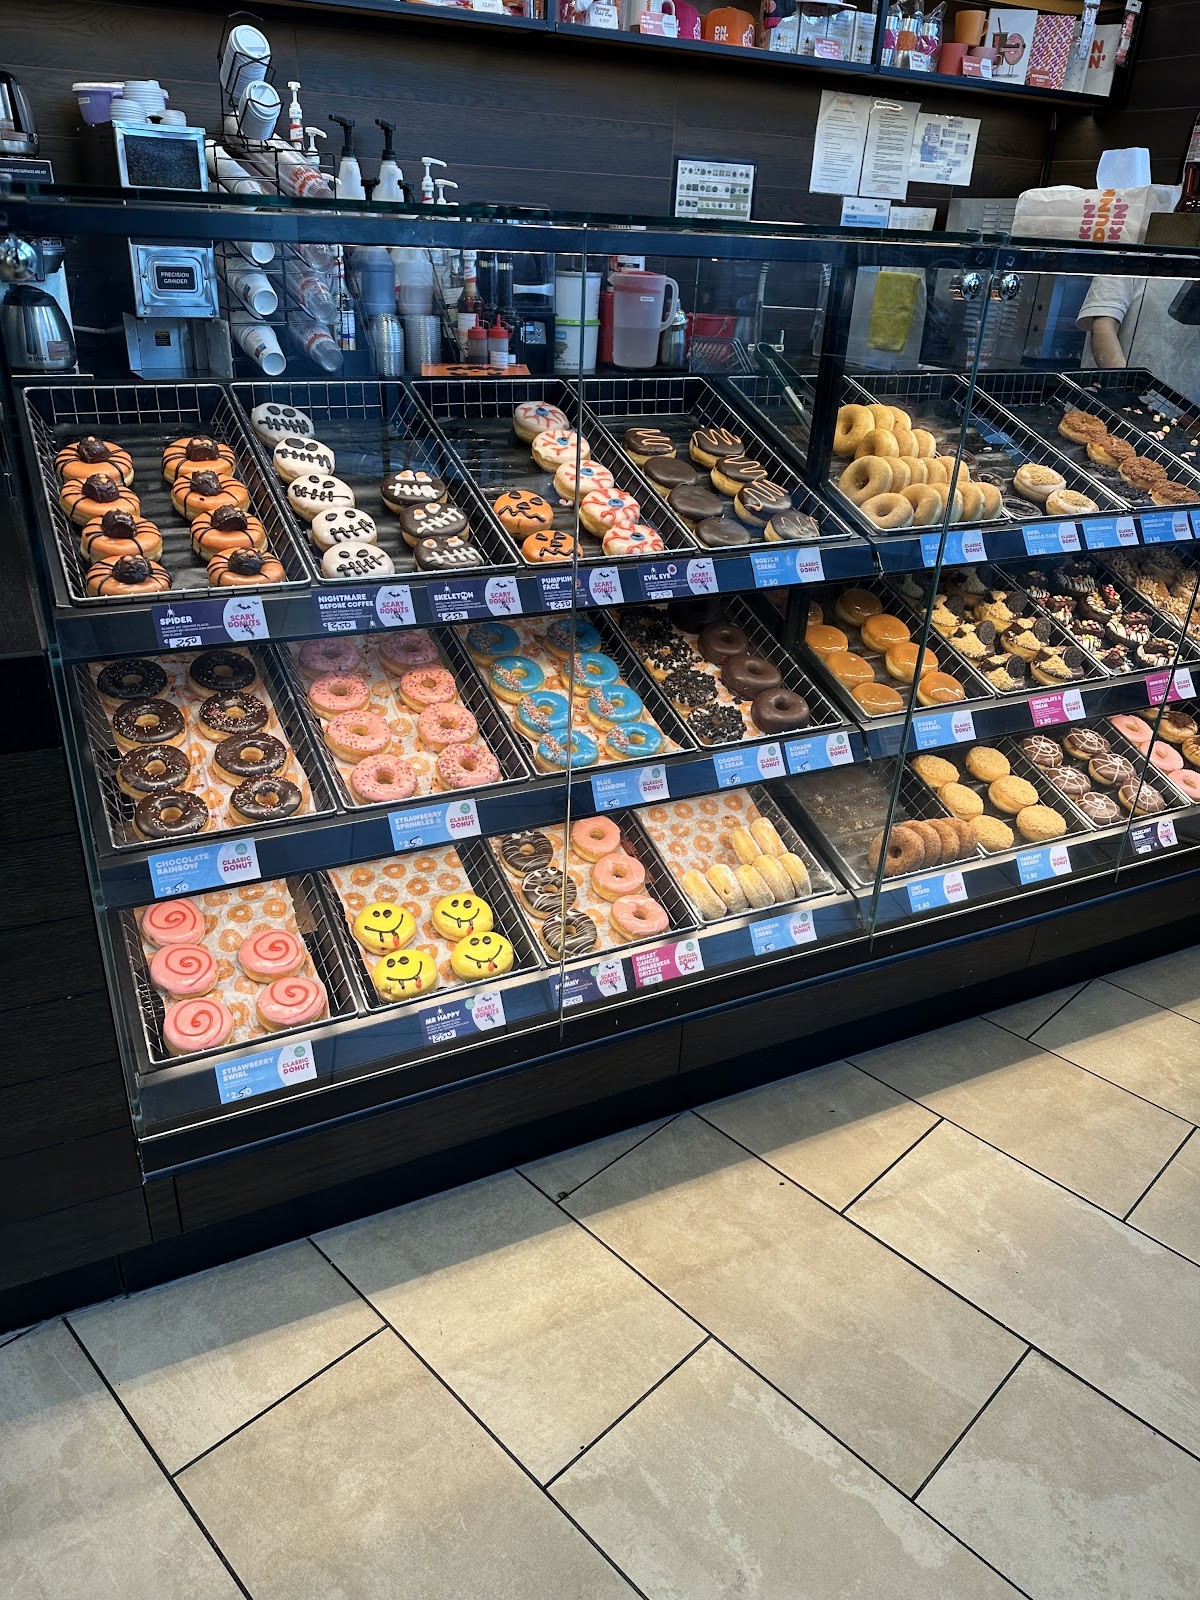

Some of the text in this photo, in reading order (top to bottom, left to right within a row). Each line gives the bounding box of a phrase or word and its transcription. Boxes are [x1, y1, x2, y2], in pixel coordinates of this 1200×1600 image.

[1079, 199, 1095, 239] KIN'
[541, 576, 572, 584] PUMPKIN
[658, 572, 671, 580] EYE
[542, 583, 560, 591] FACE
[318, 594, 367, 603] NIGHTMARE
[434, 591, 474, 601] SKELETON
[319, 602, 346, 610] BEFORE
[160, 615, 193, 626] SPIDER
[230, 613, 255, 622] SCARY
[228, 619, 261, 628] DONUTS
[830, 749, 848, 757] DONUT
[718, 755, 743, 765] COOKIES
[724, 761, 744, 769] CREAM
[761, 761, 780, 769] DONUT
[596, 778, 612, 786] BLUE
[597, 782, 626, 792] RAINBOW
[643, 784, 663, 792] DONUT
[395, 811, 442, 824] STRAWBERRY
[450, 815, 474, 823] CLASSIC
[396, 818, 434, 831] SPRINKLES
[451, 820, 475, 829] DONUT
[155, 853, 210, 868] CHOCOLATE
[222, 855, 252, 866] CLASSIC
[157, 862, 198, 876] RAINBOW
[223, 861, 253, 872] DONUT
[754, 922, 780, 933] BAVARIAN
[793, 922, 810, 930] CLASSIC
[794, 926, 811, 935] DONUT
[636, 951, 656, 962] BREAST
[678, 952, 697, 960] SPECIAL
[679, 956, 698, 966] DONUT
[637, 957, 659, 967] CANCER
[638, 959, 670, 972] AWARENESS
[601, 971, 617, 980] SCARY
[639, 967, 662, 977] DRIZZLE
[600, 976, 621, 985] DONUTS
[475, 1008, 499, 1019] DONUTS
[477, 1004, 495, 1013] SCARY
[425, 1010, 460, 1025] MR HAPPY
[221, 1056, 274, 1076] STRAWBERRY
[282, 1057, 309, 1068] CLASSIC
[283, 1063, 310, 1074] DONUT
[222, 1070, 248, 1082] SWIRL
